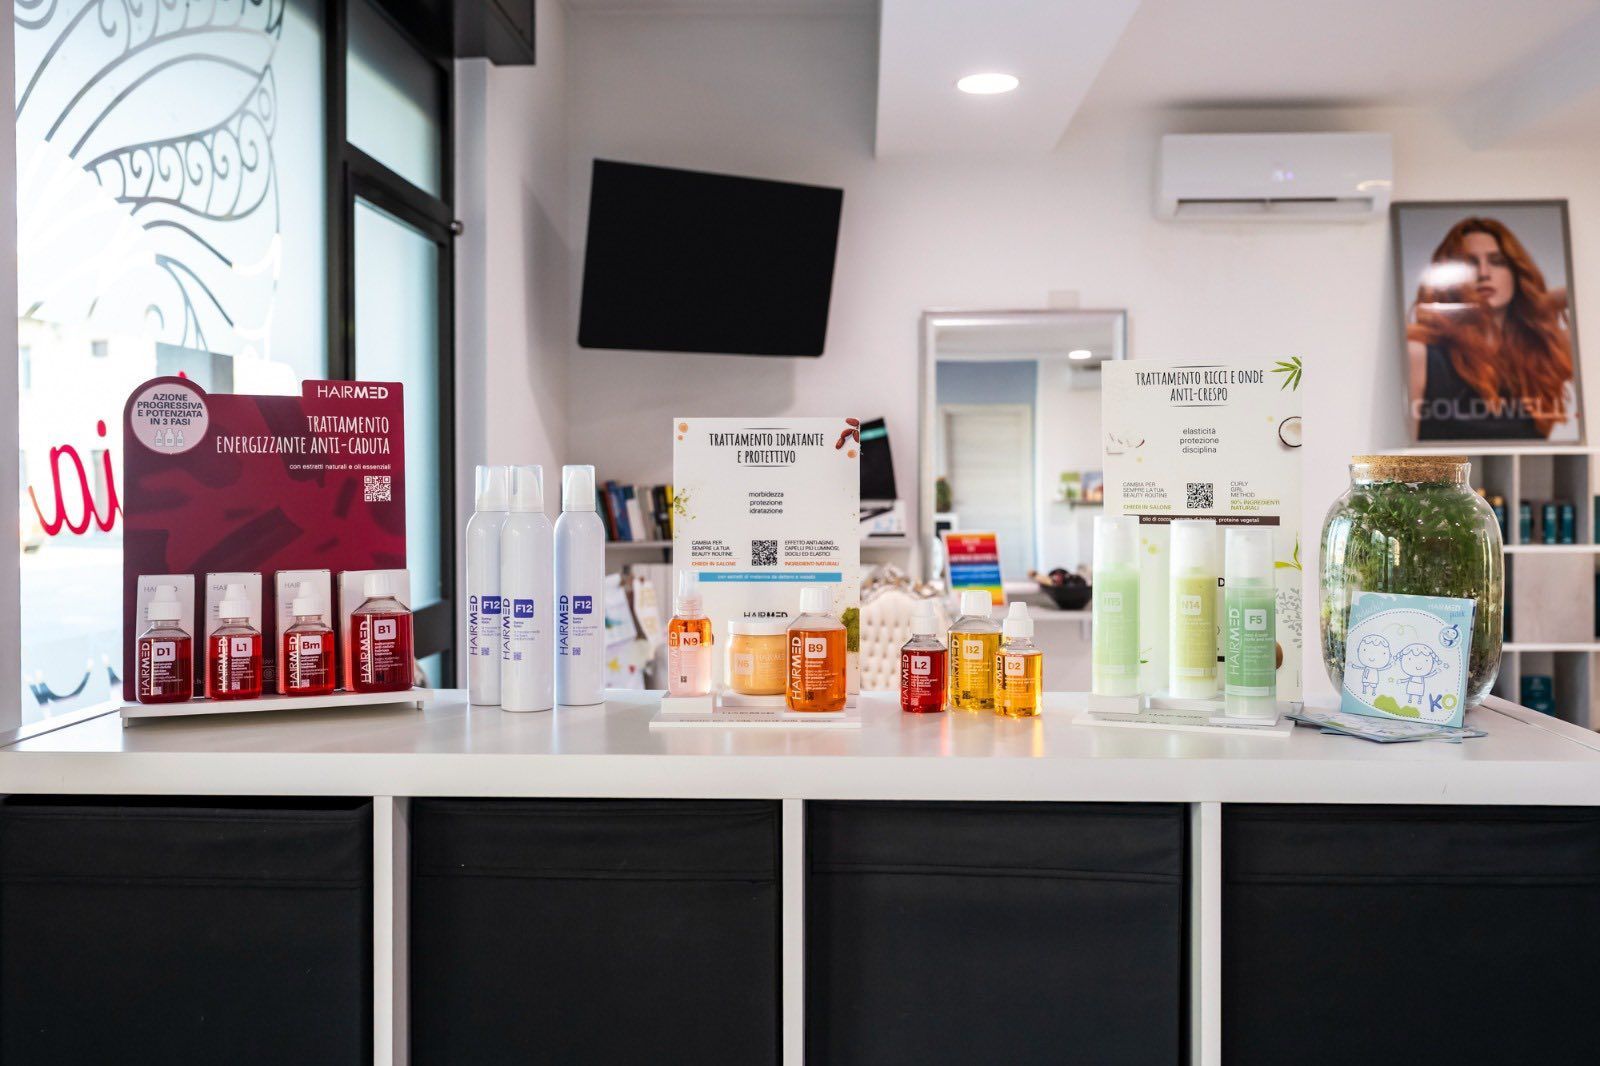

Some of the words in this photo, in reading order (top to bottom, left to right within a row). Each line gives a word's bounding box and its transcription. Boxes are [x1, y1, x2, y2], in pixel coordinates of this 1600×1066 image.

[1135, 371, 1201, 386] TRATTAMENTO
[1204, 371, 1228, 385] RICCI
[1231, 370, 1236, 384] E
[1238, 370, 1264, 384] ONDE
[318, 385, 390, 399] HAIRMED
[1170, 388, 1228, 402] ANTI-CRESPO
[152, 393, 188, 401] AZIONE
[136, 401, 203, 410] PROGRESSIVA
[136, 409, 143, 417] E
[146, 409, 203, 418] POTENZIATA
[150, 417, 161, 426] IN
[162, 417, 168, 426] 3
[170, 417, 191, 426] FASI
[306, 415, 390, 434] TRATTAMENTO
[1182, 427, 1216, 435] elasticità
[709, 433, 773, 446] TRATTAMENTO
[776, 433, 824, 446] IDRATANTE
[1179, 437, 1219, 445] protezione
[216, 436, 306, 454] ENERGIZZANTE
[310, 437, 391, 455] ANTI-CADUTA
[1182, 446, 1217, 454] disciplina
[737, 450, 742, 463] E
[744, 450, 796, 463] PROTETTIVO
[483, 601, 501, 610] F12
[516, 604, 533, 613] F12
[574, 601, 592, 610] F12
[1249, 615, 1262, 624] F5
[378, 625, 391, 634] B1
[470, 595, 478, 656] HAIRMED
[503, 598, 511, 660] HAIRMED
[560, 595, 569, 656] HAIRMED
[302, 641, 320, 650] Bm
[683, 637, 698, 646] N9
[1229, 609, 1240, 675] HAIRMED
[156, 647, 170, 656] D1
[236, 643, 247, 652] L1
[360, 621, 369, 683] HAIRMED
[808, 643, 823, 653] B9
[289, 637, 298, 688] HAIRMED
[914, 661, 927, 670] L2
[1007, 662, 1021, 670] D2
[141, 642, 150, 696] HAIRMED
[792, 636, 801, 701] HAIRMED
[902, 654, 910, 706] HAIRMED
